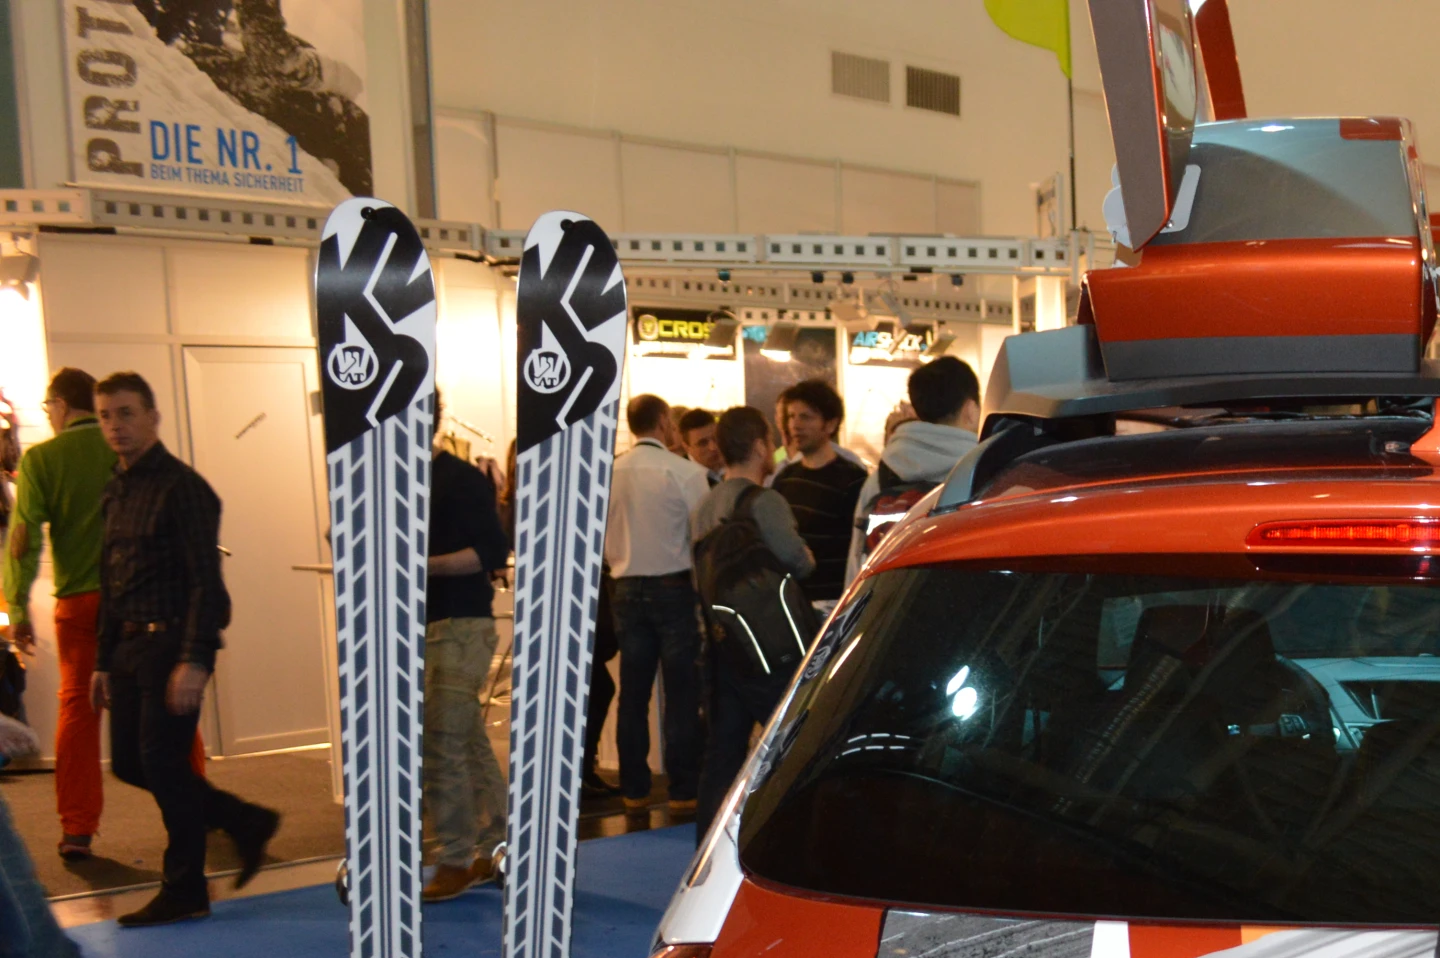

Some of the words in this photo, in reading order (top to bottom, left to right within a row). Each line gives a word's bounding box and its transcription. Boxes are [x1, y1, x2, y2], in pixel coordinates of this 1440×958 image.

[76, 0, 144, 177] PROT
[150, 120, 203, 165] DIE
[216, 127, 272, 171] NR.
[284, 135, 303, 174] 1
[151, 163, 182, 181] BEIM
[186, 168, 230, 186] THEMA
[233, 172, 304, 192] SICHERHEIT
